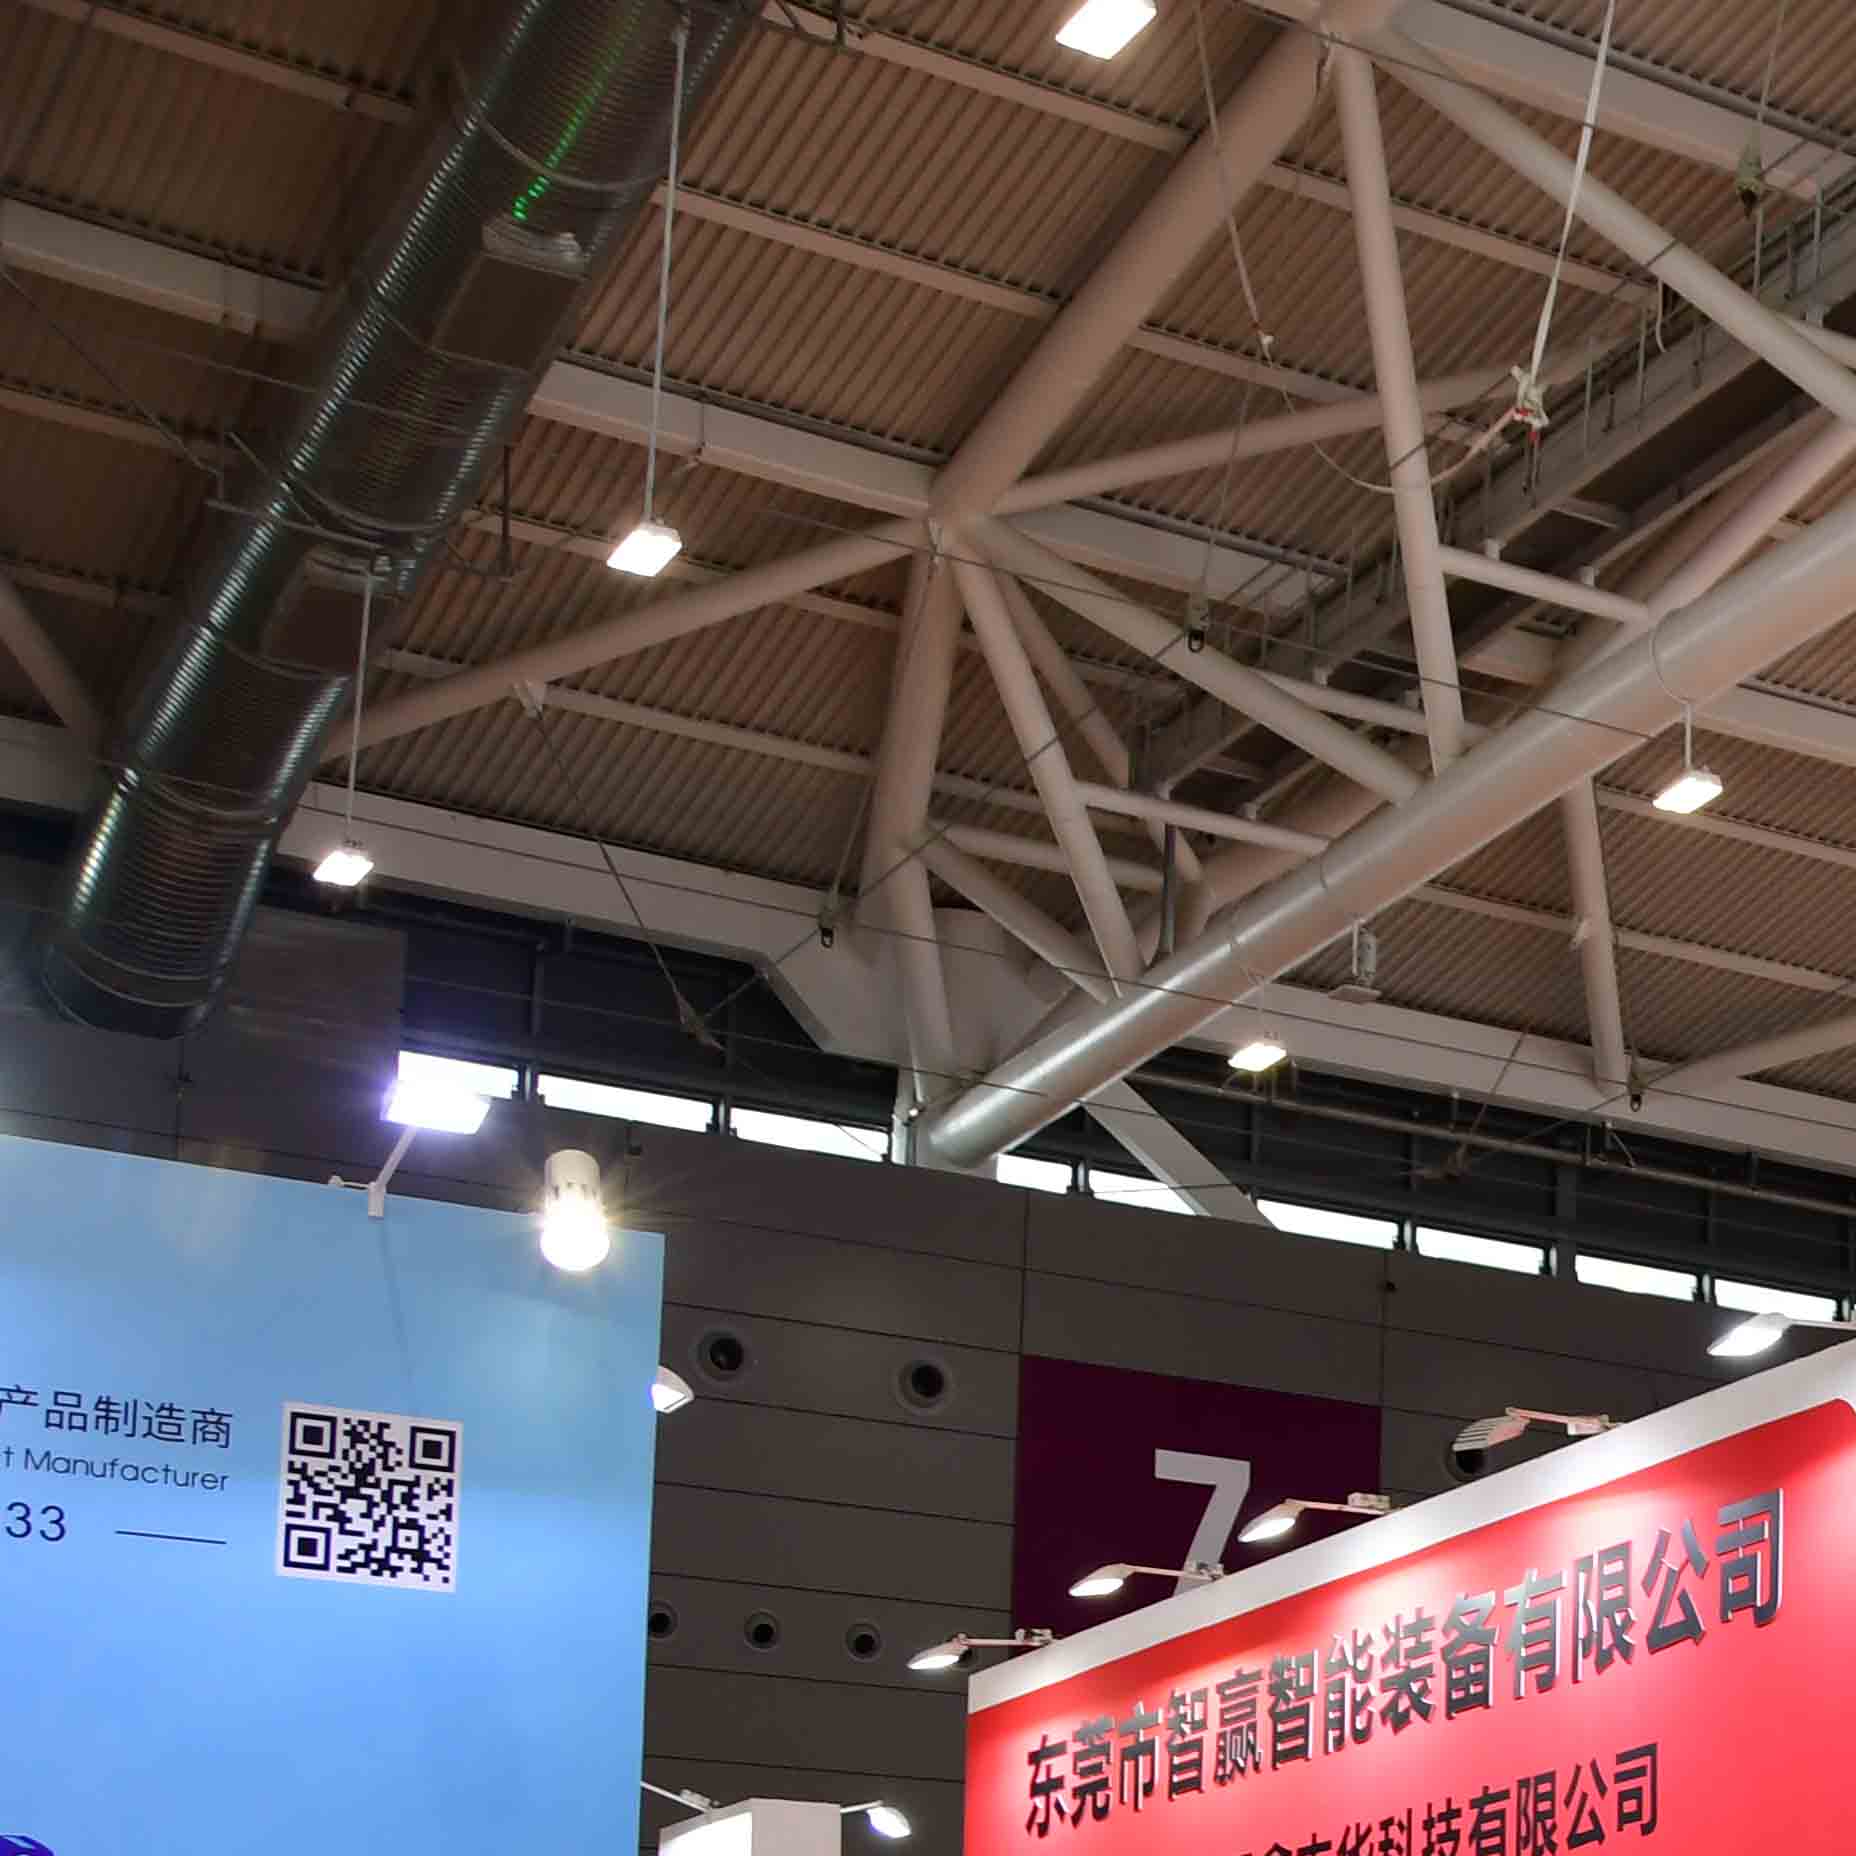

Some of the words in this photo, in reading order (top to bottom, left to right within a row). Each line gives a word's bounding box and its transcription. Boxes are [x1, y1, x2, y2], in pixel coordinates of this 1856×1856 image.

[0, 1384, 233, 1448] 产品制造商
[24, 1447, 229, 1491] Manufacturer
[5, 1502, 66, 1541] 33
[1153, 1448, 1251, 1598] 7
[1025, 1487, 1786, 1839] 东莞市智赢智能装备有限公司
